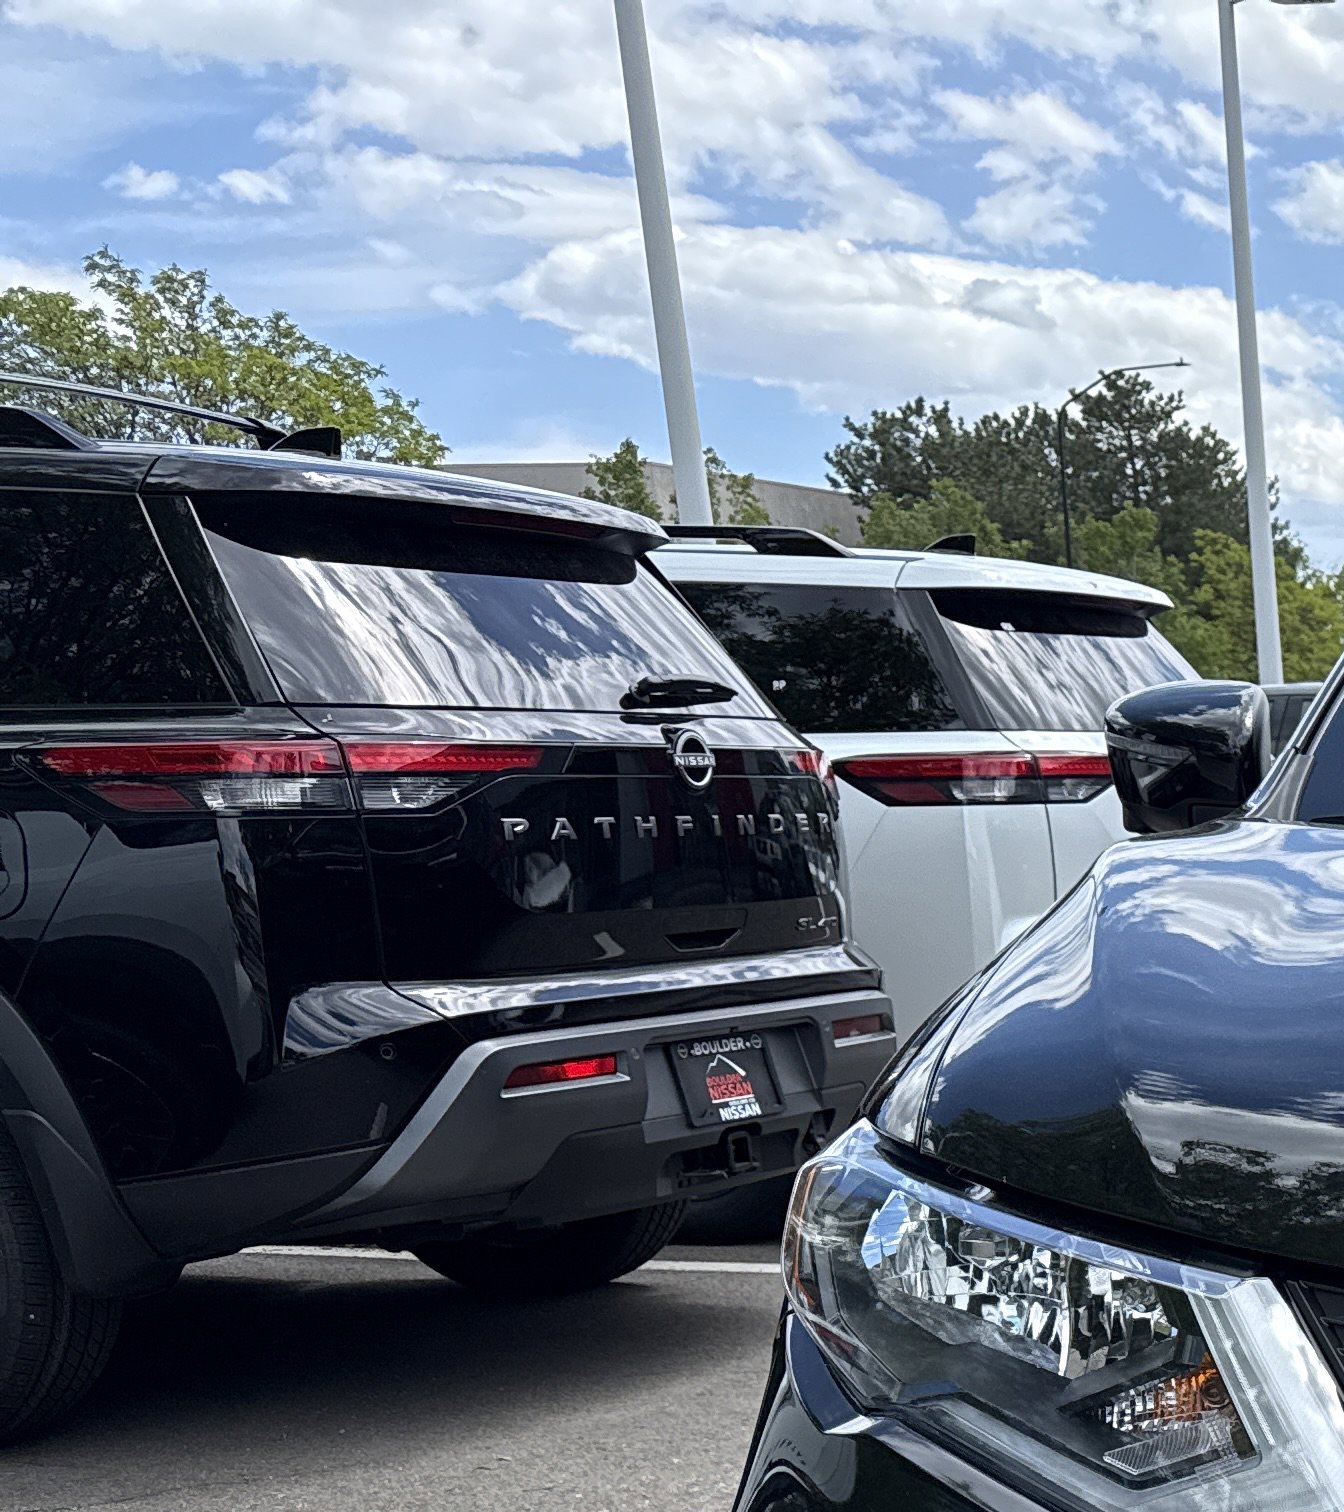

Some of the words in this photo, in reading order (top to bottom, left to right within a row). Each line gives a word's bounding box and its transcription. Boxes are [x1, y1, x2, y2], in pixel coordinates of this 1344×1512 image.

[500, 812, 831, 840] PATHFINDER
[693, 1037, 746, 1056] BOULDER
[708, 1081, 753, 1100] NISSAN
[719, 1101, 762, 1121] NISSAN
